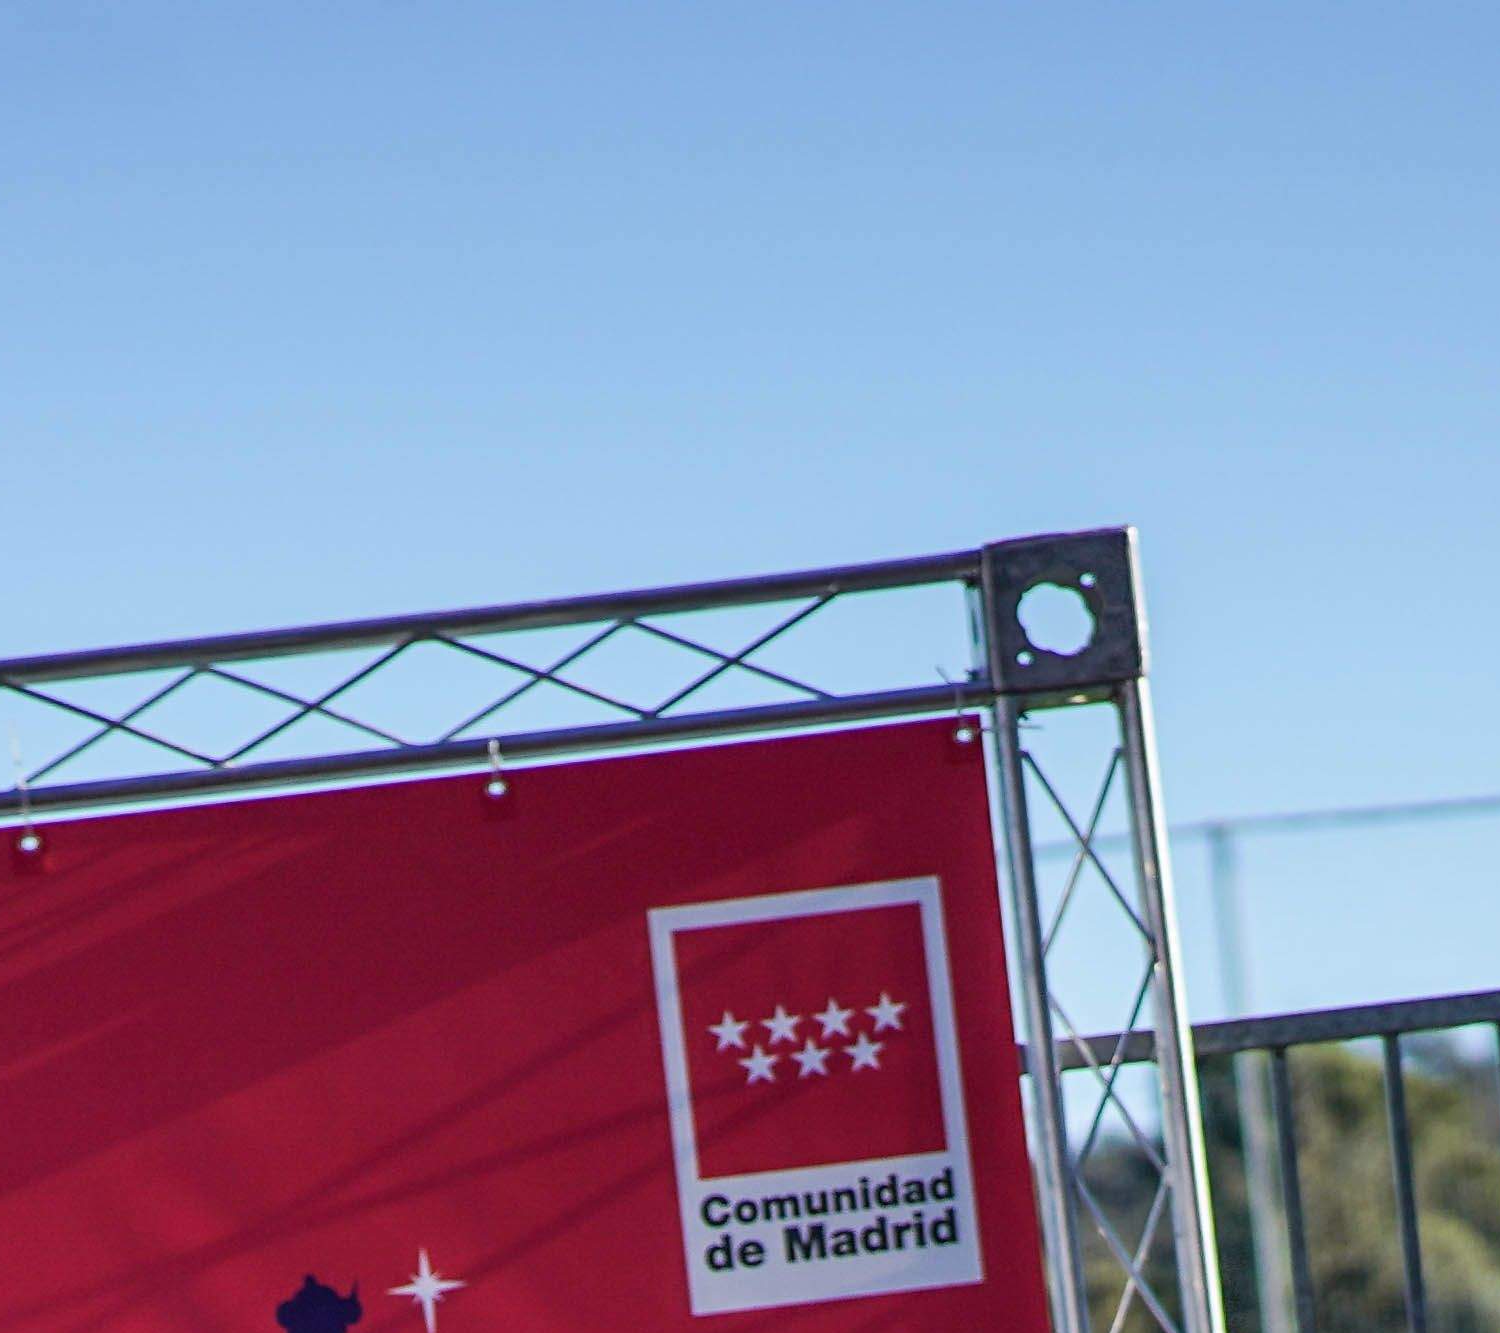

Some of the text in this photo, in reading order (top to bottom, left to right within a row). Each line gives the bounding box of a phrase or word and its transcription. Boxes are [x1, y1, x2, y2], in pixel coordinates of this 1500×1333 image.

[699, 1166, 957, 1229] Comunidad
[704, 1206, 960, 1273] de Madrid
